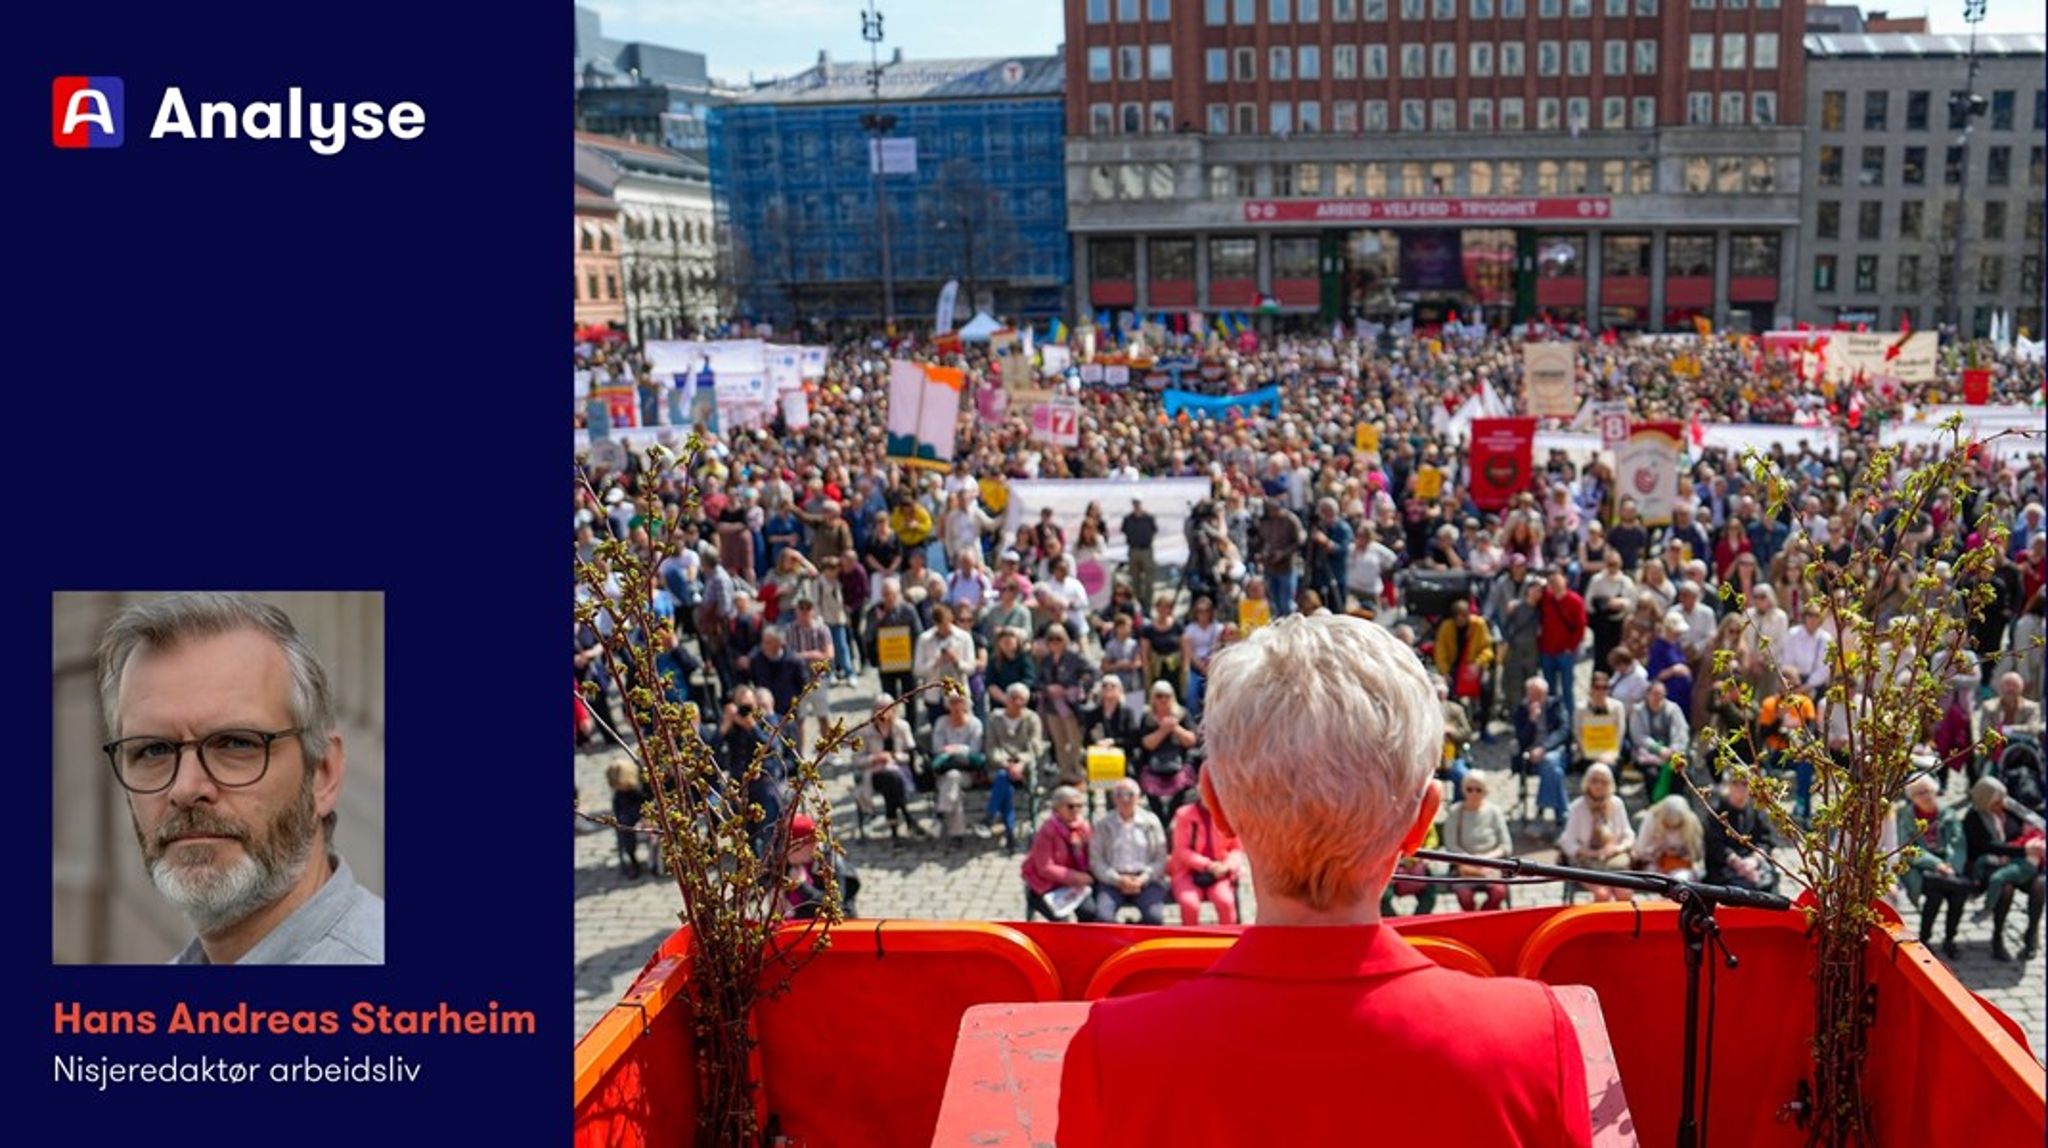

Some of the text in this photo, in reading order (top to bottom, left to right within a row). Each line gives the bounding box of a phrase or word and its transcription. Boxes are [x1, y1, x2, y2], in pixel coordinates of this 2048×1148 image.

[1316, 202, 1371, 217] ARBEID
[1053, 410, 1073, 432] 7
[1605, 415, 1624, 439] 8
